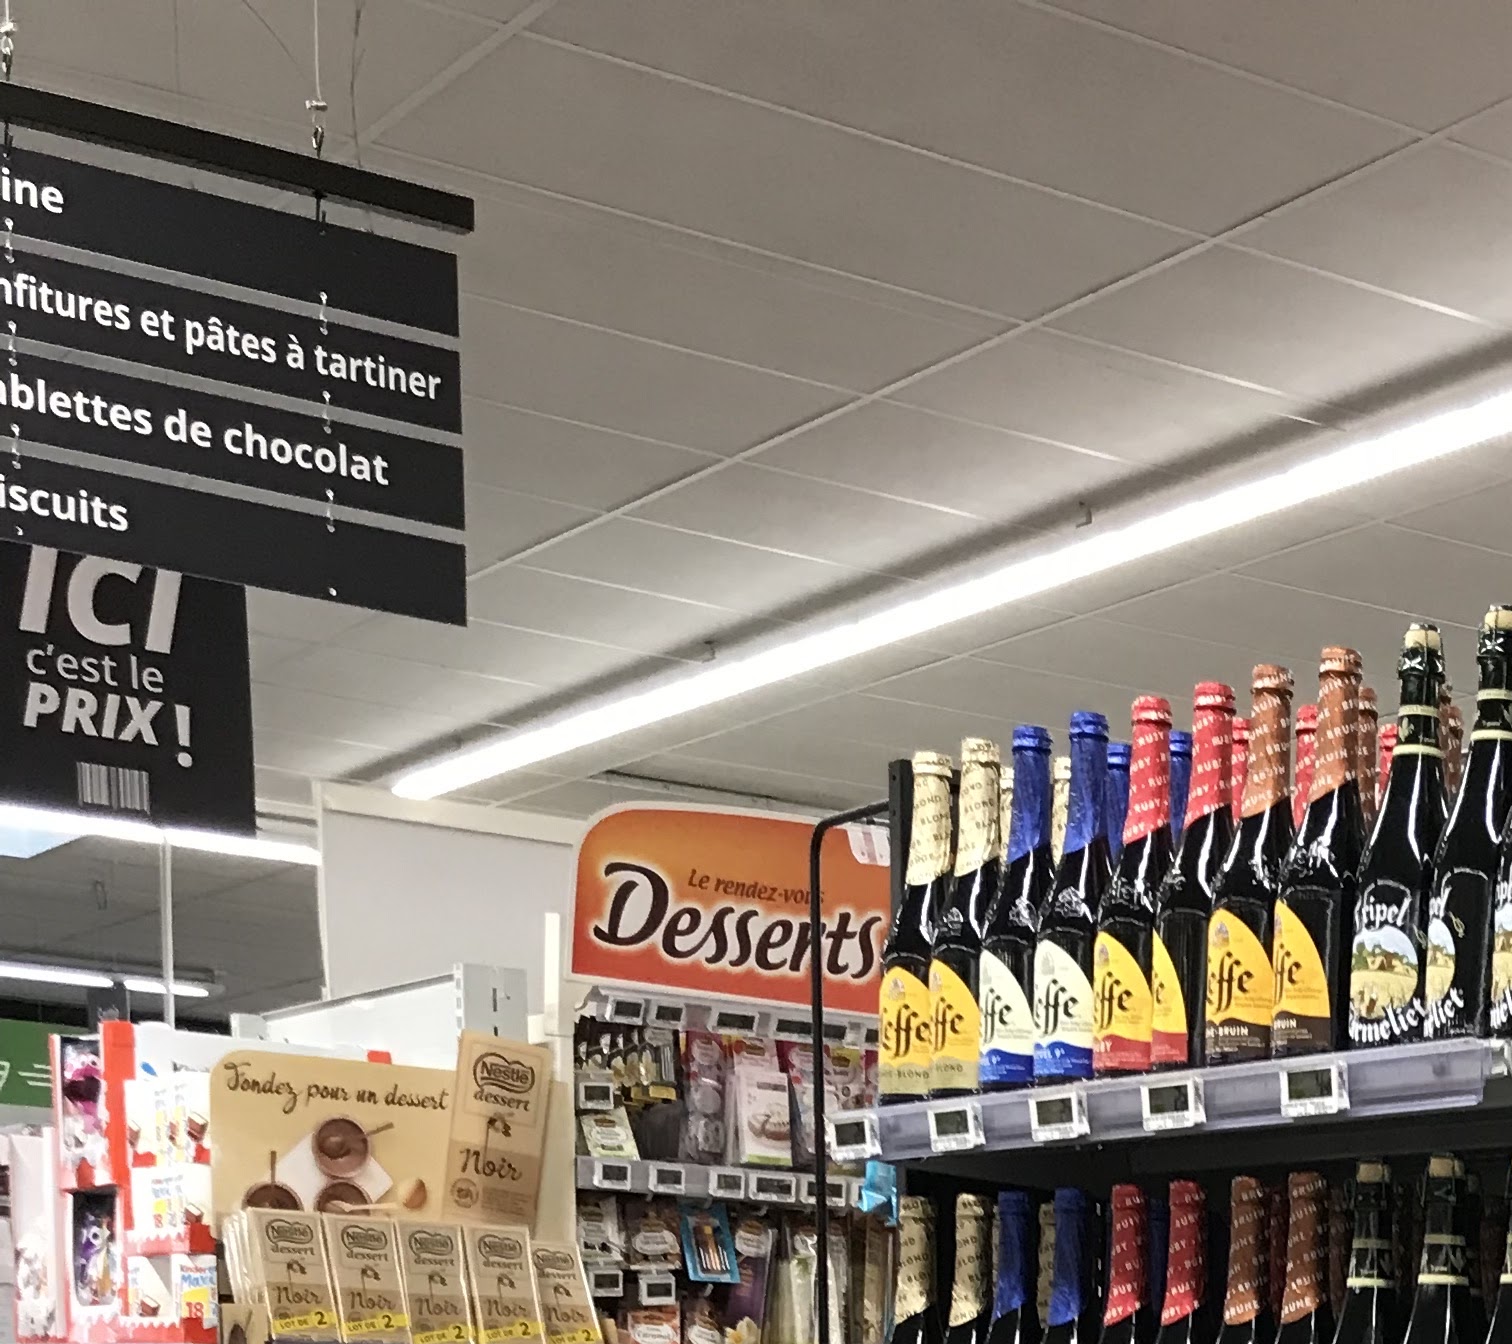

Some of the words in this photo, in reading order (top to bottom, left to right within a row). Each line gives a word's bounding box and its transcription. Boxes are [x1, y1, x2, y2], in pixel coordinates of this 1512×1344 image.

[140, 309, 175, 341] et
[185, 314, 277, 365] pâtes
[286, 335, 305, 371] à
[315, 343, 442, 401] tartiner
[164, 409, 212, 447] de
[224, 421, 390, 486] chocolat
[18, 545, 184, 655] ICI
[26, 645, 117, 687] c'est
[130, 655, 164, 693] le
[688, 868, 708, 890] Le
[593, 862, 882, 979] Desserts
[224, 1062, 297, 1114] Fondez
[305, 1081, 348, 1106] pour
[356, 1087, 379, 1105] un
[384, 1085, 449, 1112] dessert
[473, 1088, 531, 1113] dessert
[459, 1147, 523, 1183] Noir
[272, 1284, 323, 1306] Noir
[347, 1289, 397, 1311] Noir
[415, 1296, 462, 1318] Noir
[315, 1312, 328, 1327] 2
[382, 1314, 395, 1330] 2
